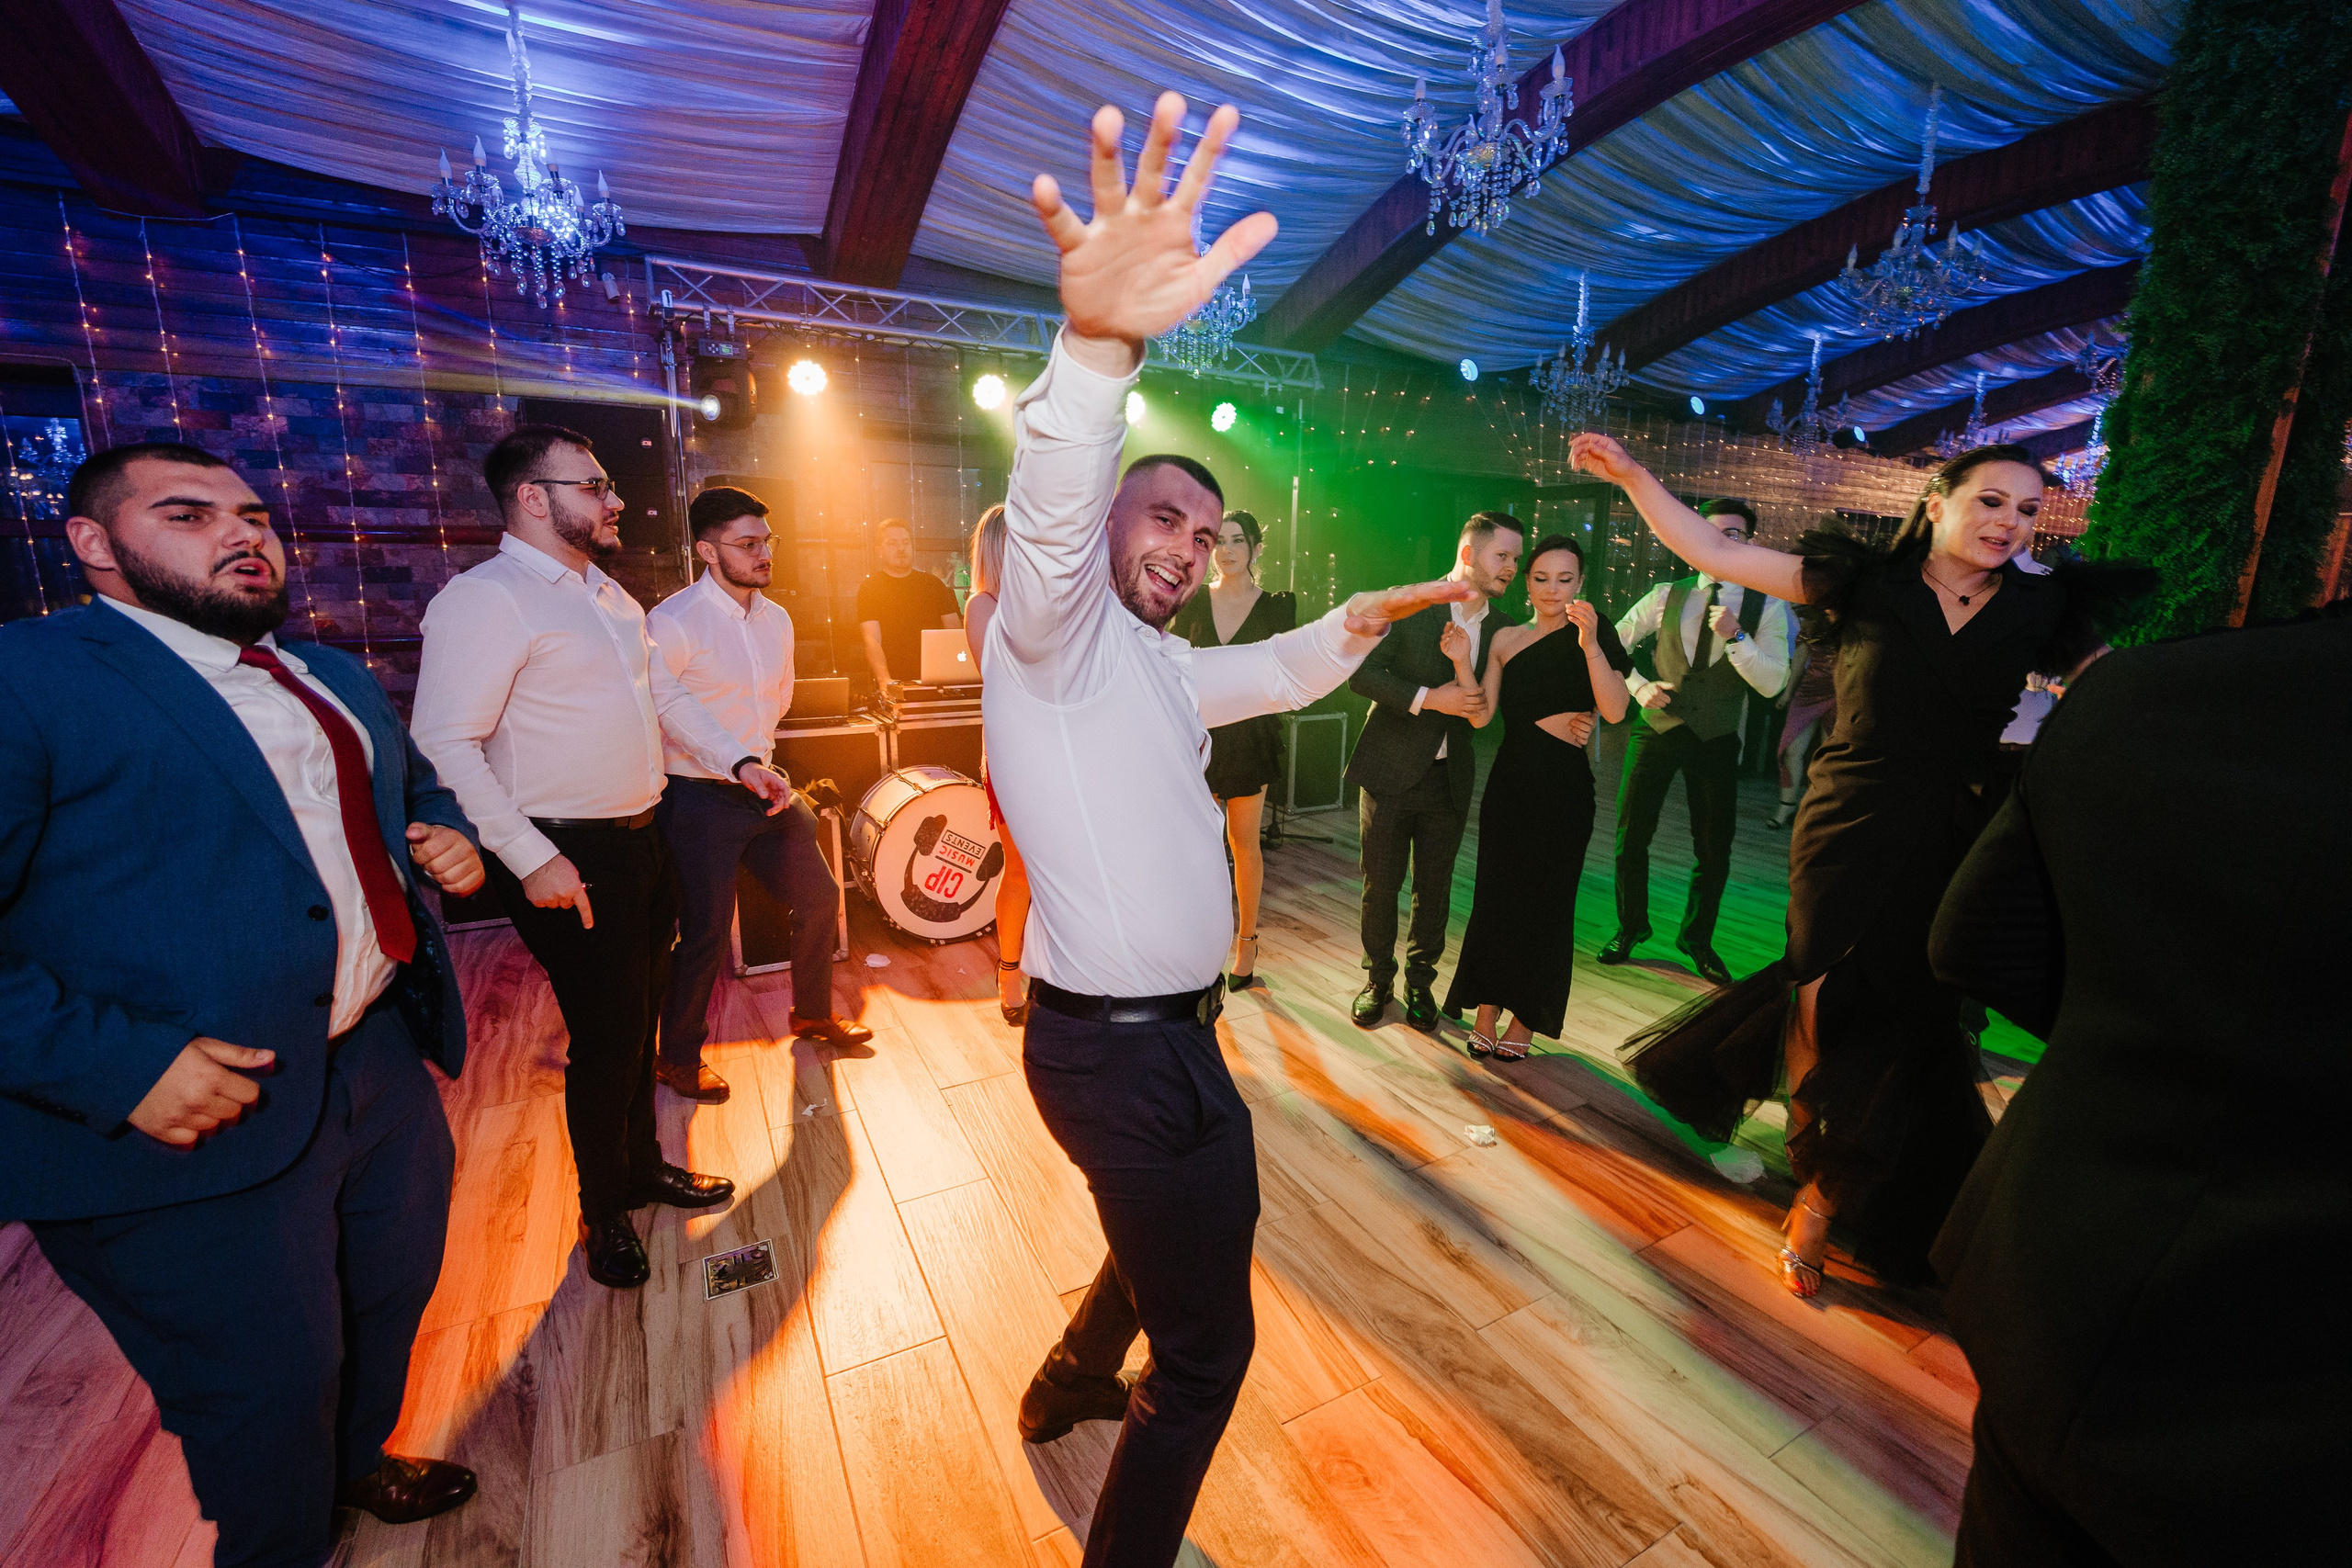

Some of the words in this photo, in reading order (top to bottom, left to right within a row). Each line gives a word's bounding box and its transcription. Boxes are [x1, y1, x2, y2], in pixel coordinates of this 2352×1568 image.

[946, 834, 982, 855] EVENTS
[939, 845, 975, 867] MUSIC
[924, 865, 964, 898] CIP
